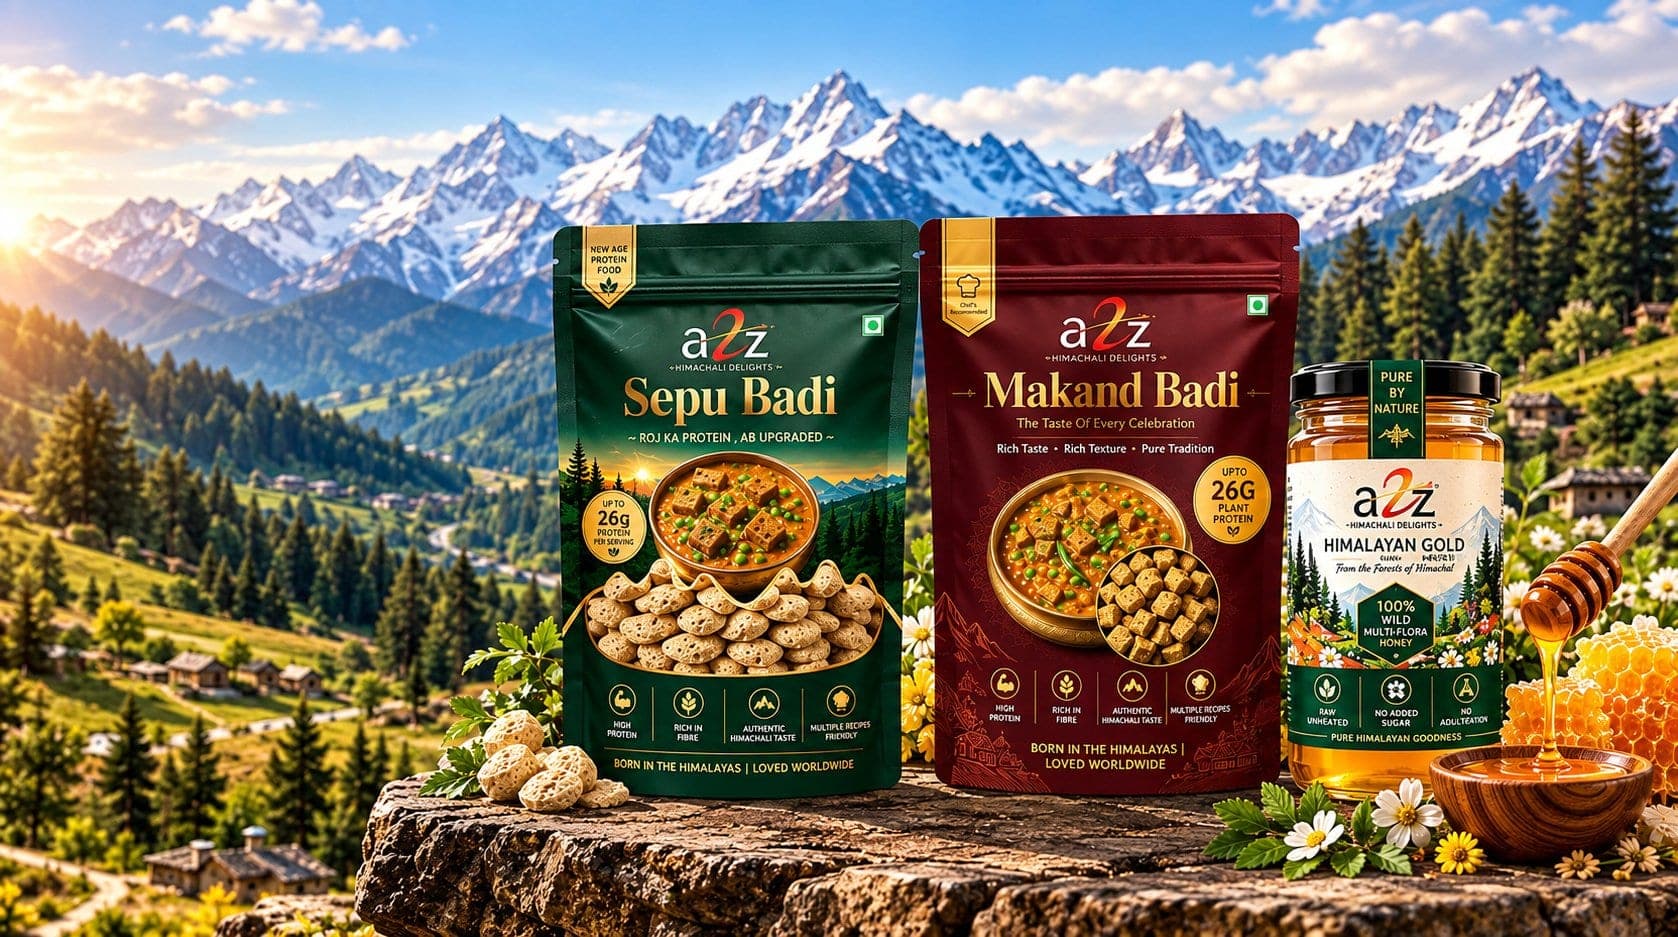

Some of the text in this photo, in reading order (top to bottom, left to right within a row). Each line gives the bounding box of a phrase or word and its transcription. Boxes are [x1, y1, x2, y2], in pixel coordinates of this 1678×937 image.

[597, 266, 621, 274] FOOD
[1060, 296, 1151, 350] a2z
[681, 308, 770, 361] a2z
[1052, 354, 1157, 362] HIMACHALI DELIGHTS
[676, 363, 773, 372] HIMACHALI DELIGHTS
[1381, 372, 1413, 382] PURE
[983, 370, 1240, 408] Makand Badi
[1389, 387, 1405, 398] BY
[624, 375, 837, 426] Sepu Badi
[1374, 403, 1419, 414] NATURE
[1016, 417, 1195, 431] The Taste Of Every Celebration
[639, 432, 823, 444] ROJ KA PROTEIN AB UPGRADED
[997, 443, 1215, 454] Rich Taste Rich Texture Pure Tradition
[1222, 468, 1247, 476] UPTO
[1211, 480, 1255, 500] 26G
[1354, 467, 1436, 519] a2z
[1218, 504, 1249, 512] PLANT
[598, 510, 630, 528] 26g
[1213, 515, 1253, 523] PROTEIN
[1350, 521, 1437, 529] HIMACHALI DELIGHTS
[1324, 538, 1465, 552] HIMALAYAN GOLD
[1358, 563, 1371, 572] the
[1373, 563, 1402, 573] Forests
[1404, 563, 1415, 575] of
[1415, 563, 1455, 572] Himachal
[1376, 600, 1415, 613] 100%
[1381, 615, 1411, 625] WILD
[1363, 627, 1428, 636] MULTI-FLORA
[1379, 638, 1413, 648] HONEY
[995, 704, 1015, 712] HIGH
[1112, 707, 1153, 715] AUTHENTIC
[1170, 706, 1203, 714] MULTIPLE
[1319, 708, 1336, 716] RAW
[1461, 708, 1472, 716] NO
[1375, 709, 1419, 717] NO ADDED
[989, 714, 1021, 722] PROTEIN
[1056, 716, 1078, 724] FIBRE
[1101, 716, 1163, 724] HIMACHALI TASTE
[1307, 717, 1349, 726] UNHEATED
[614, 721, 631, 729] HIGH
[810, 723, 844, 732] MULTIPLE
[1381, 719, 1411, 727] SUGAR
[694, 724, 703, 732] IN
[743, 725, 785, 733] AUTHENTIC
[607, 730, 637, 739] PROTEIN
[677, 733, 699, 741] FIBRE
[730, 734, 796, 742] HIMACHALI TASTE
[1331, 733, 1462, 743] PURE HIMALAYAN GOODNESS
[1031, 743, 1178, 755] BORN IN THE HIMALAYAS
[614, 758, 854, 774] BORN IN THE HIMALAYAS LOVED WORLDWIDE
[1045, 758, 1166, 770] LOVED WORLDWIDE
